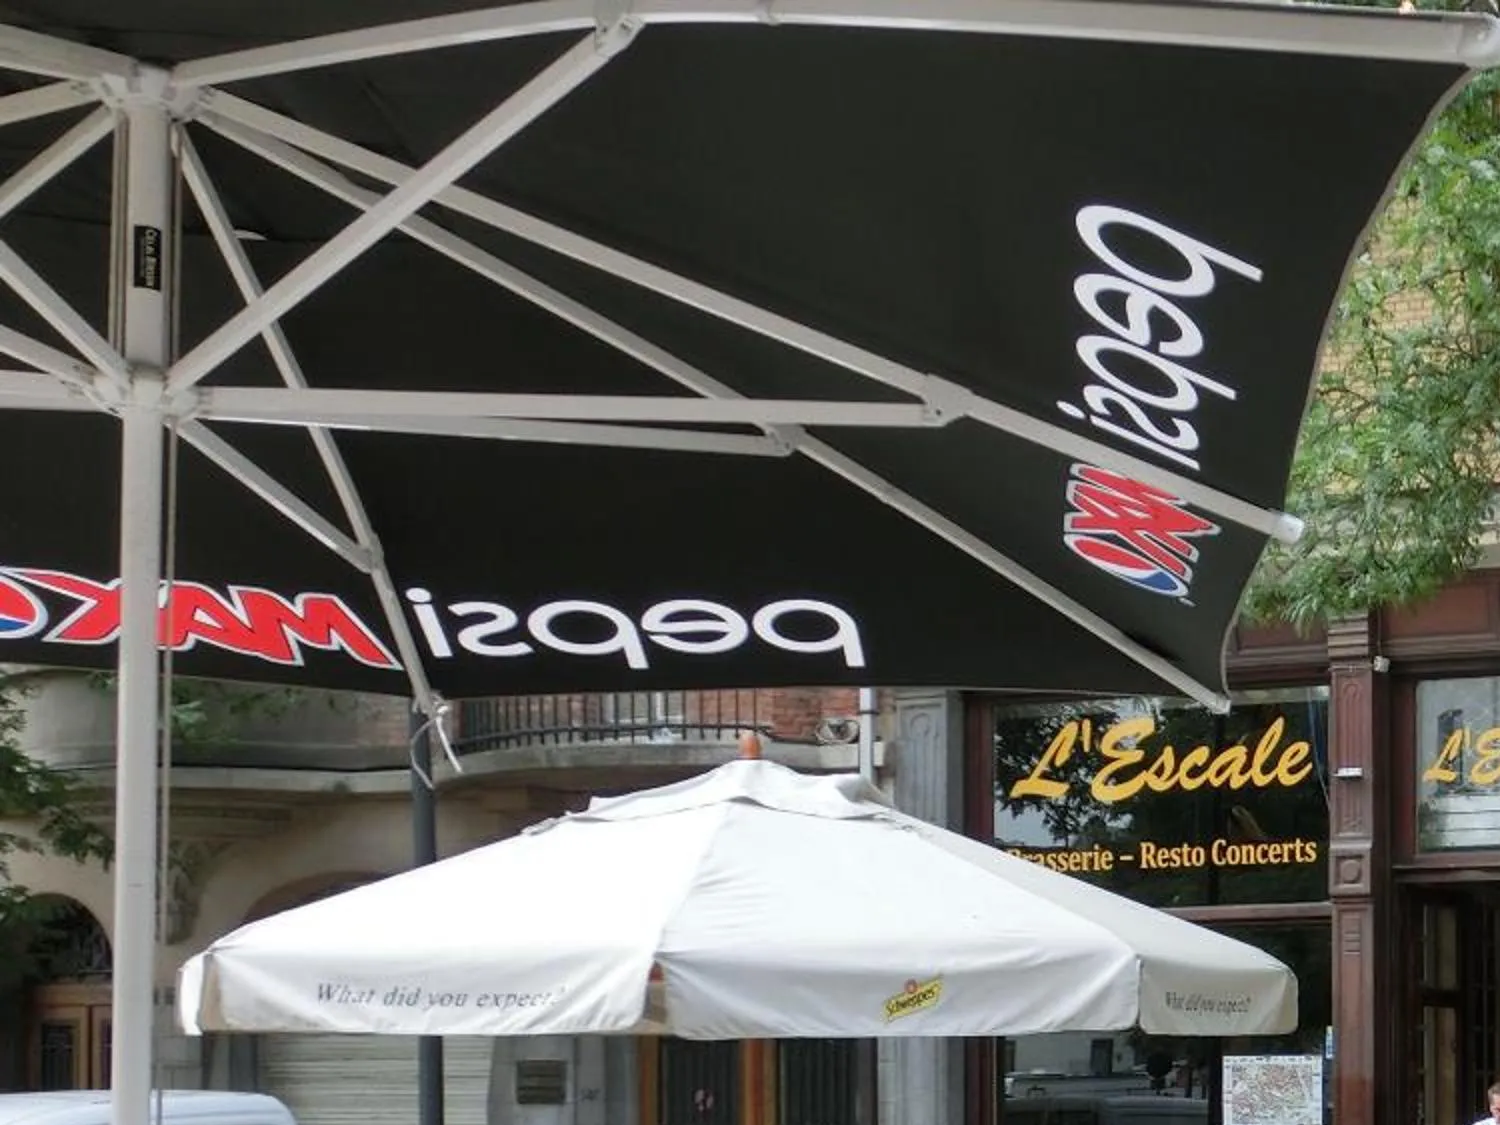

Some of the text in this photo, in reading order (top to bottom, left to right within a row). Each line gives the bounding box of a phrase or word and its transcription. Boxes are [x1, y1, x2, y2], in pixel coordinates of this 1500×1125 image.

[1009, 715, 1313, 804] L'Escale
[1140, 841, 1204, 869] Resto
[1211, 837, 1318, 866] Concerts
[317, 982, 375, 1005] What
[383, 986, 421, 1007] did
[424, 991, 468, 1012] you
